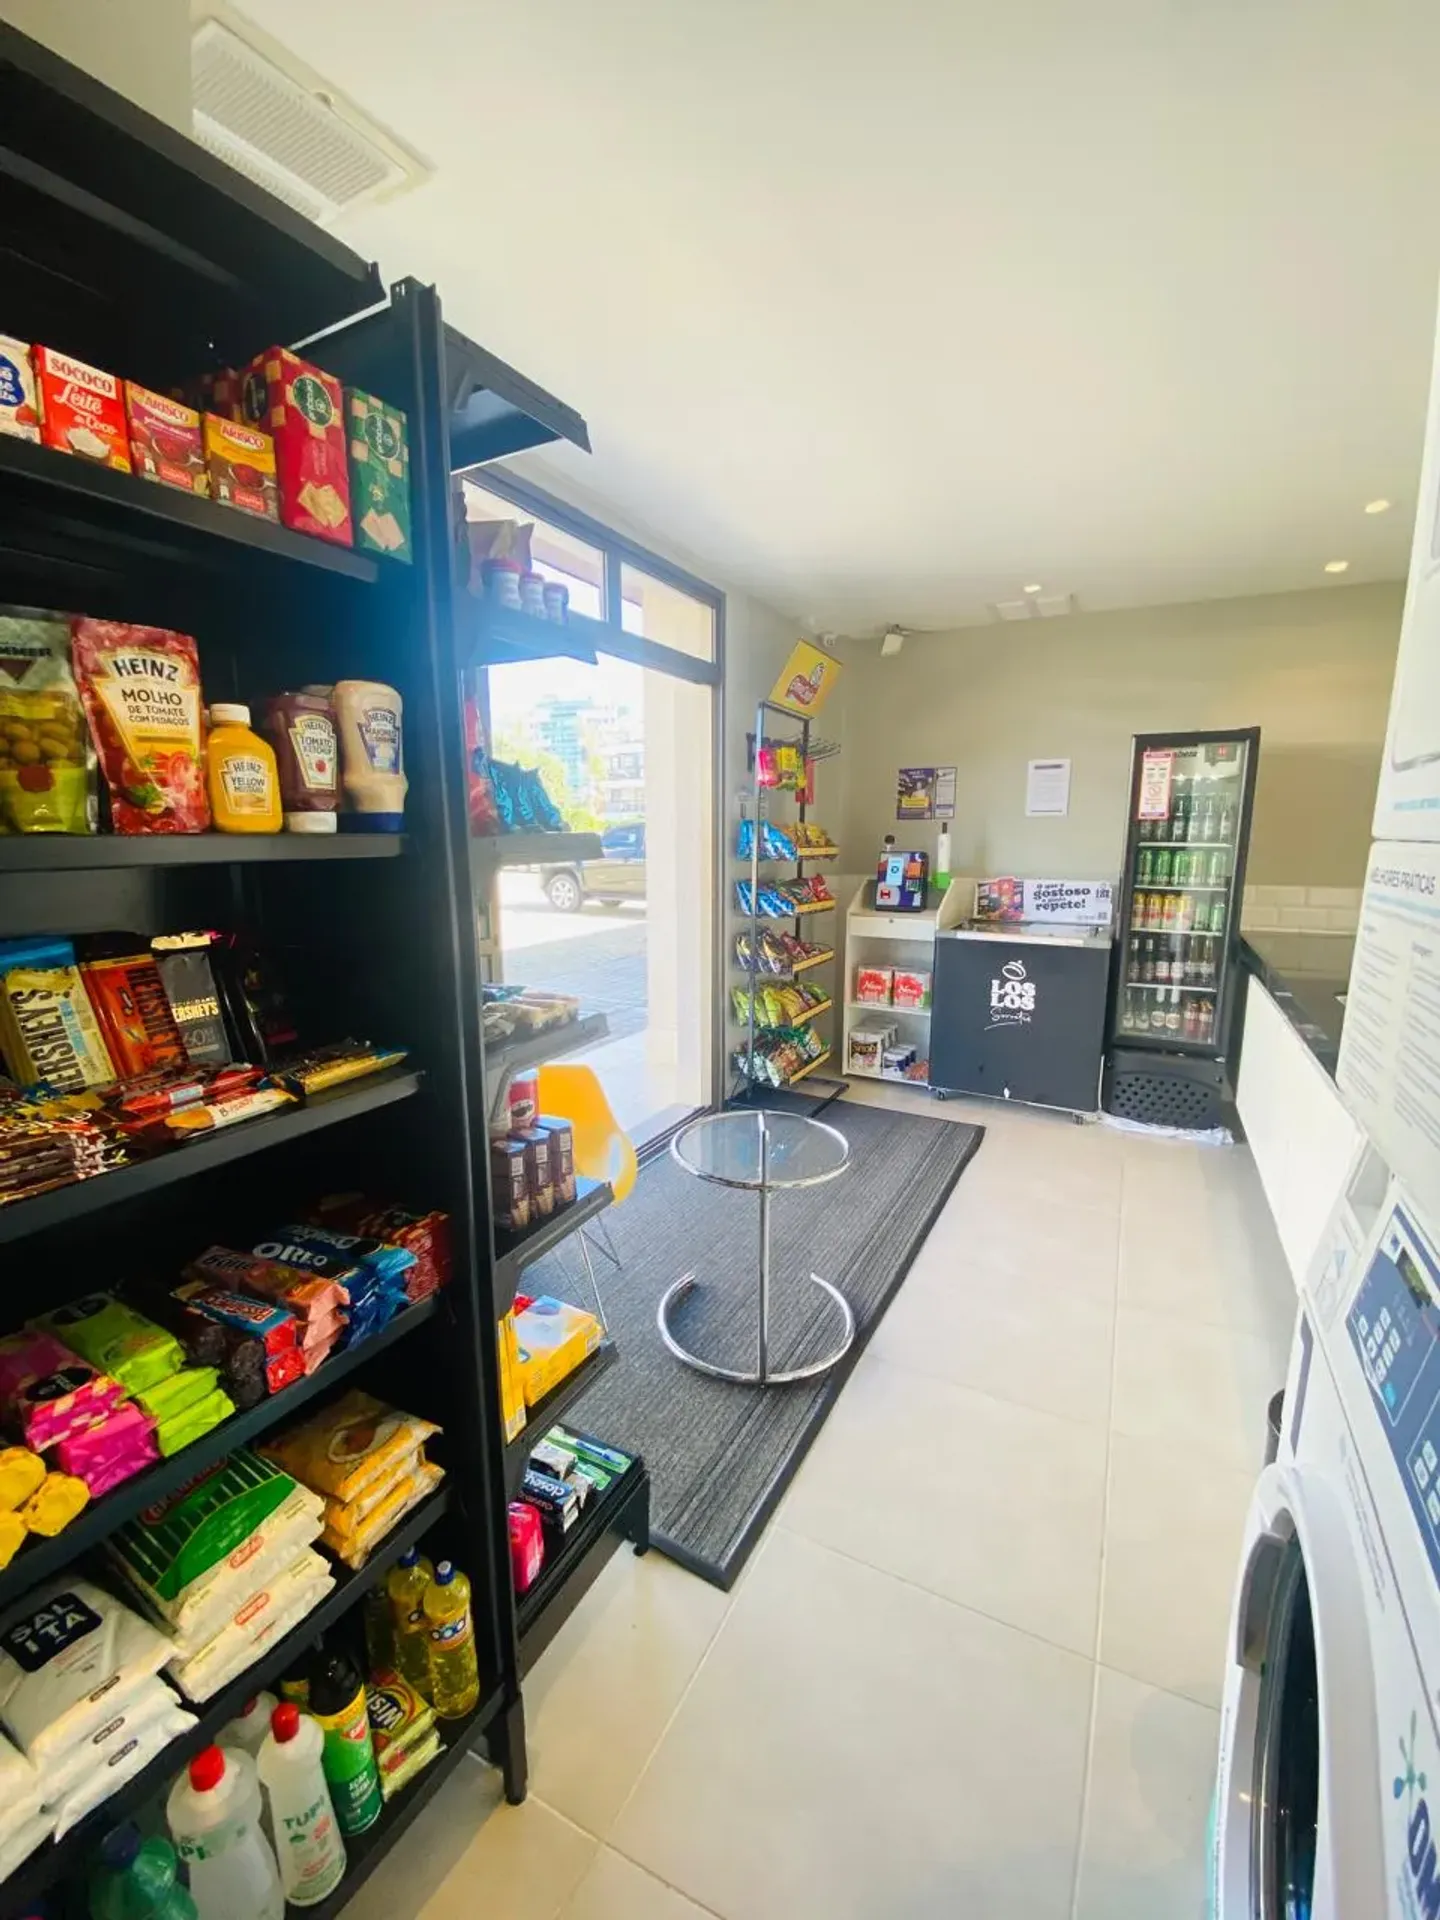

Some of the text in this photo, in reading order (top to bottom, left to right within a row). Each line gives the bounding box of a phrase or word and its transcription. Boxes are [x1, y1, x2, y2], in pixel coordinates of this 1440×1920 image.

[50, 357, 113, 394] SOCOCO
[53, 382, 103, 416] Leite
[222, 422, 265, 449] ARISCO
[112, 658, 179, 683] HEINZ
[121, 688, 183, 706] MOLHO
[127, 704, 186, 718] DE TOMATE
[129, 714, 149, 725] COM
[368, 711, 394, 724] HEINZ
[303, 719, 331, 735] HEINZ
[232, 761, 263, 774] HEINZ
[231, 775, 266, 787] YELLOW
[1032, 886, 1092, 902] gostoso
[1035, 899, 1087, 913] repete!
[991, 979, 1036, 996] LOS
[990, 993, 1035, 1011] LOS
[173, 1001, 220, 1024] ERSHEY'S
[9, 988, 87, 1095] HERSHEY'S
[252, 1242, 329, 1267] OREO
[10, 1603, 76, 1644] SAL
[24, 1610, 89, 1653] ITA
[282, 1794, 325, 1830] TUPI
